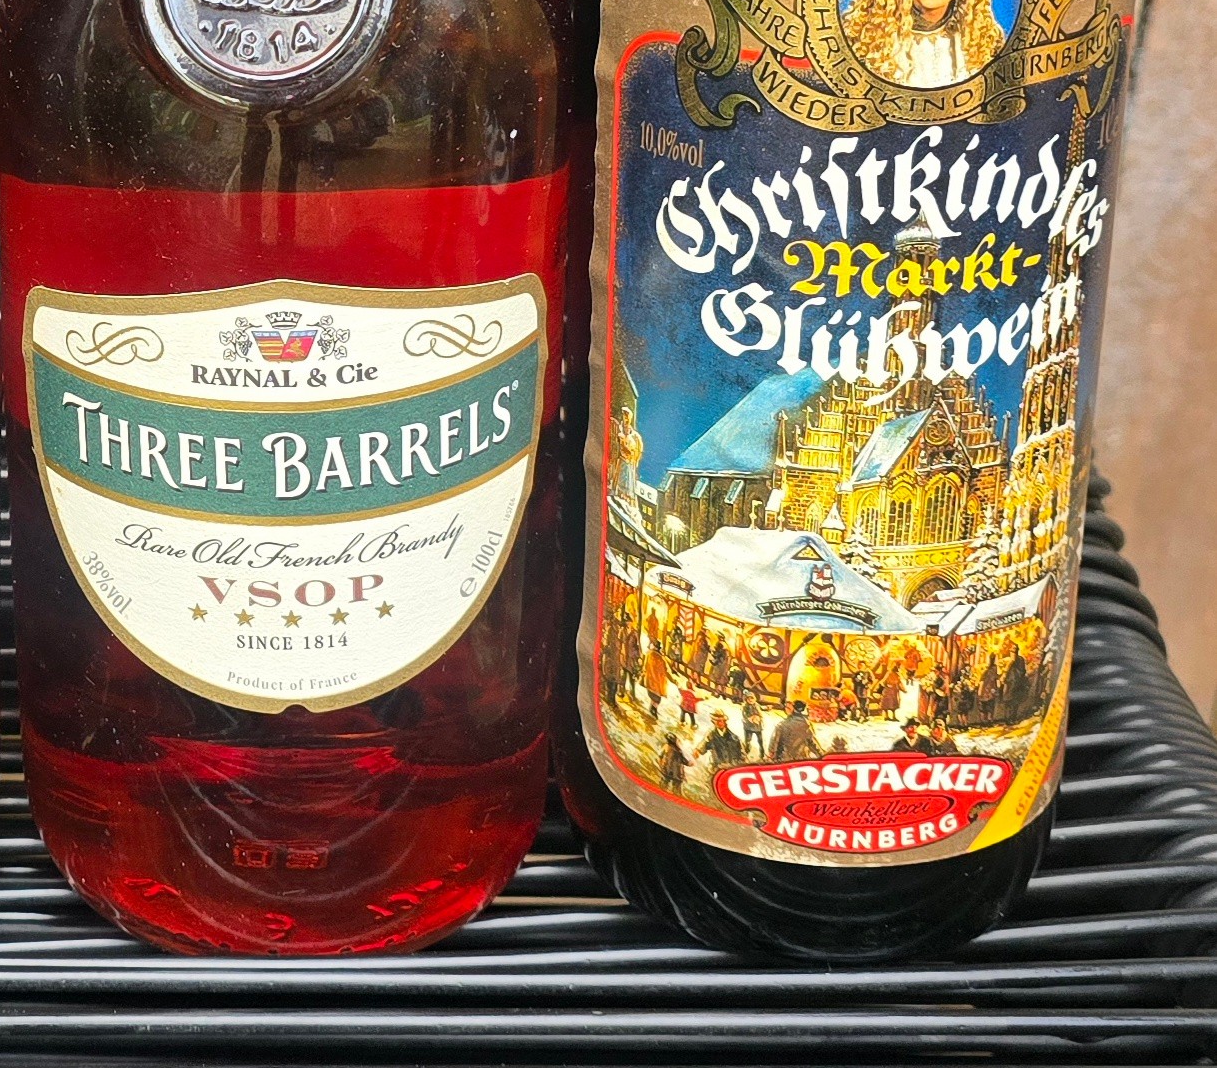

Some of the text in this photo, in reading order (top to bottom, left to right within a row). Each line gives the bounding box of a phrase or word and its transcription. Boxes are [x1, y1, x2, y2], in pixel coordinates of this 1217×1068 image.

[991, 27, 1105, 89] NÜRNBERG
[759, 62, 873, 126] WIEDER
[783, 232, 1041, 298] Markt-
[701, 275, 1084, 406] Glühwein
[190, 362, 379, 389] RAYNAL & Cie
[61, 390, 246, 495] THREE
[115, 512, 465, 569] Rare Old French Brandy
[471, 530, 503, 573] 100cl
[197, 574, 385, 608] VSOP
[236, 632, 349, 651] SINCE 1814
[226, 670, 359, 691] Product of France
[727, 762, 1003, 801] GERSTACKER
[812, 798, 932, 818] Weinkellerei
[777, 812, 958, 849] NÜRNBERG
